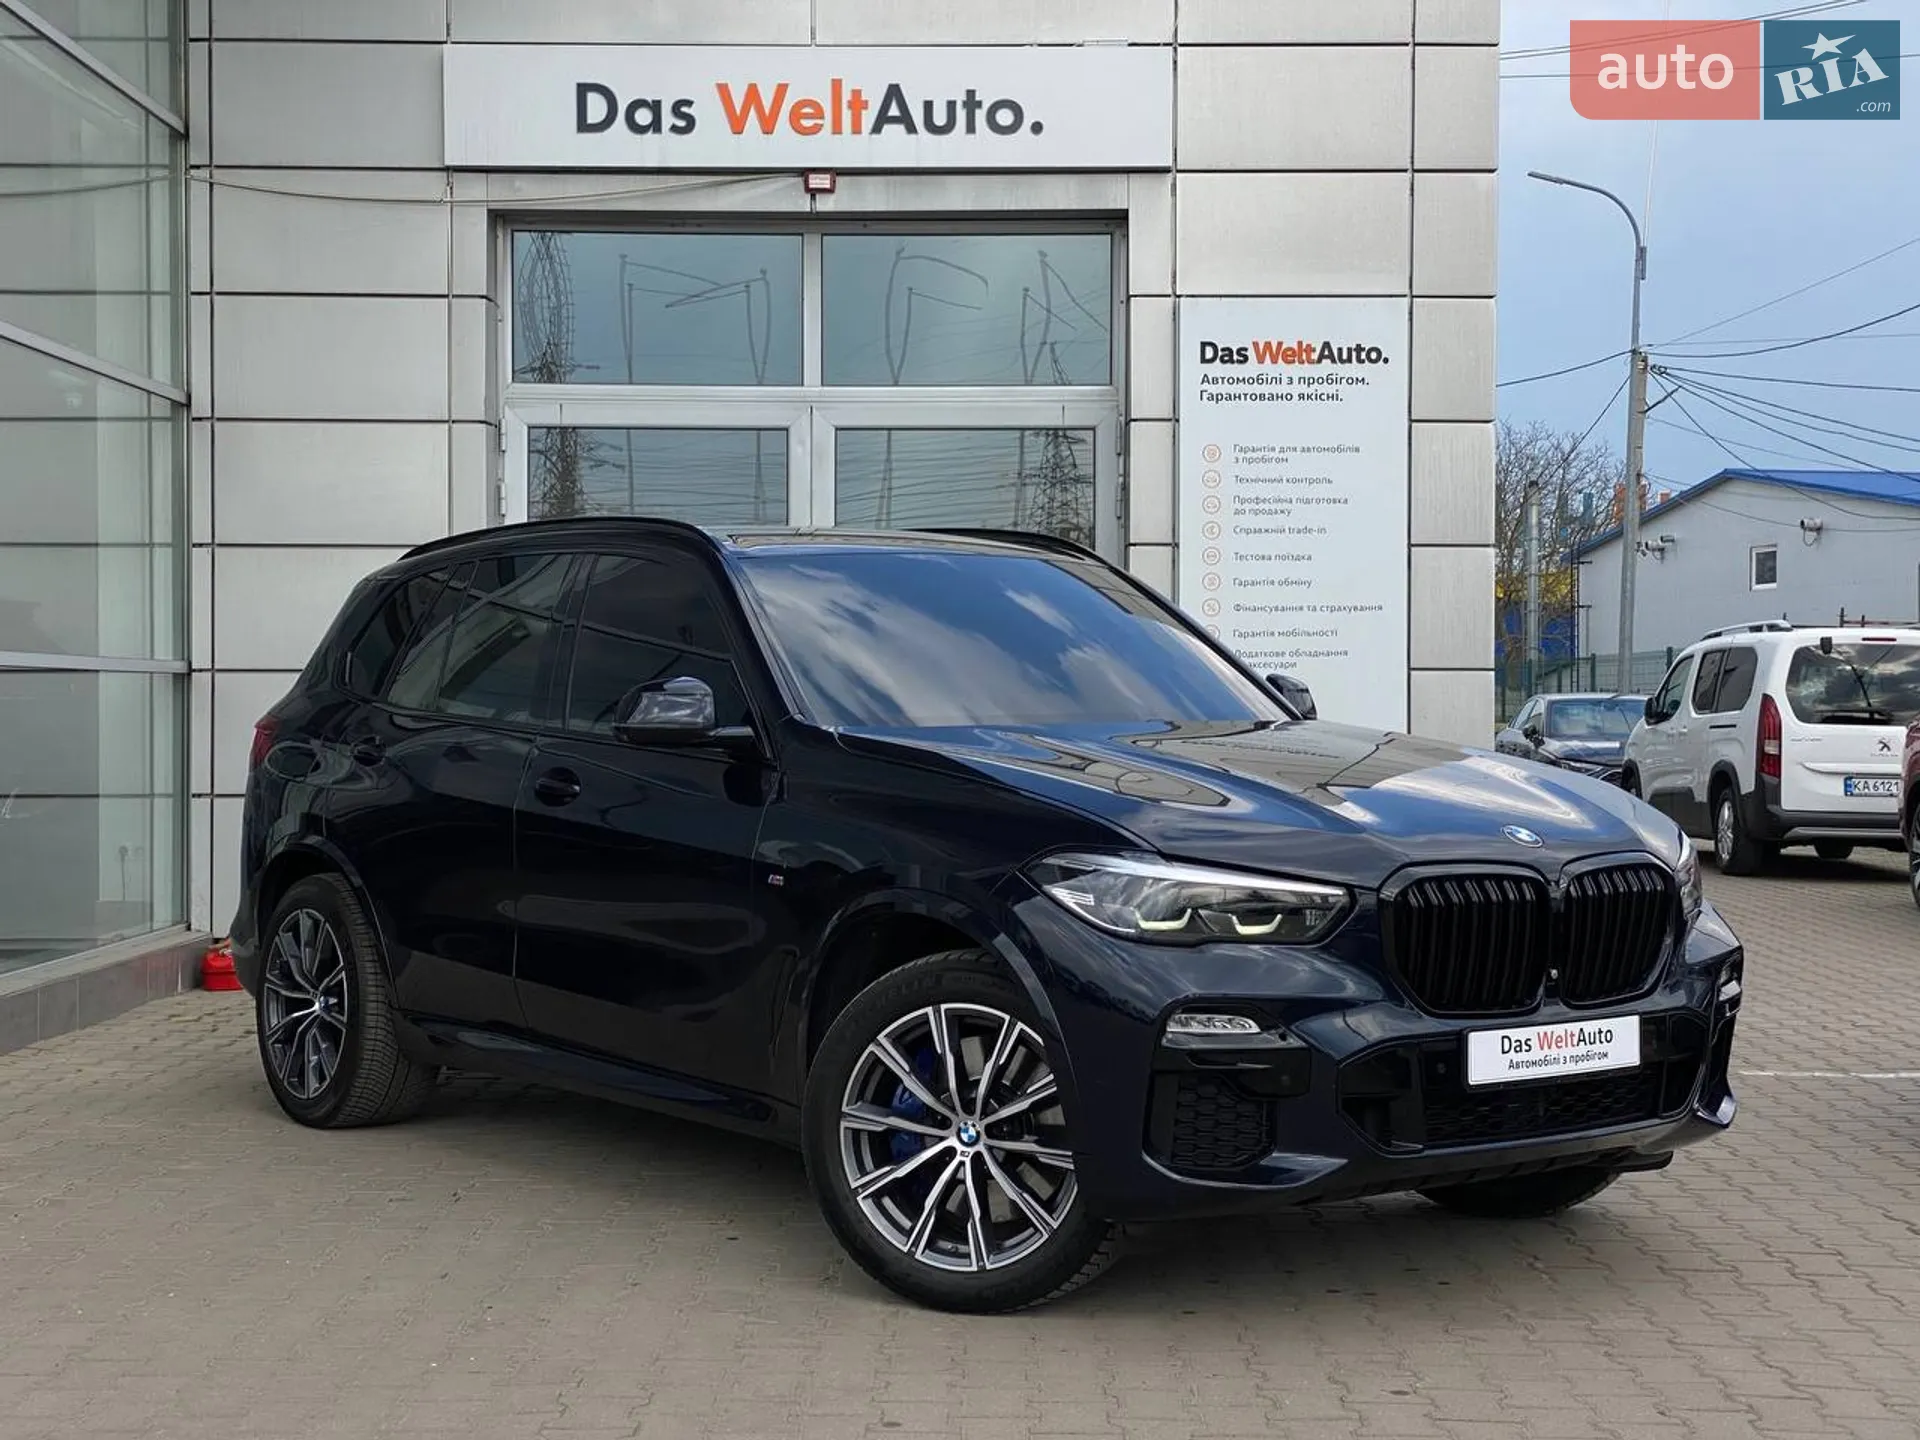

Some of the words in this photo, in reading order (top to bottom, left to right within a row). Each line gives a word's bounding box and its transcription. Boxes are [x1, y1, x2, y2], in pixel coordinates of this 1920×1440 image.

[576, 83, 696, 135] Das
[716, 79, 1043, 136] WeltAuto.
[1200, 341, 1249, 364] Das
[1253, 341, 1389, 365] WeltAuto.
[1201, 373, 1282, 385] Автомобілі
[1287, 377, 1293, 385] з
[1298, 373, 1369, 387] пробігом.
[1200, 390, 1293, 404] Гарантовано
[1298, 389, 1343, 402] якісні.
[1233, 444, 1277, 454] Гарантія
[1278, 446, 1298, 454] для
[1285, 476, 1334, 487] контроль
[1233, 507, 1247, 516] до
[1248, 507, 1293, 518] продажу
[1287, 525, 1327, 535] trade-in
[1233, 551, 1273, 562] Тестова
[1232, 578, 1275, 588] Гарантія
[1306, 604, 1318, 613] та
[1232, 629, 1276, 639] Гарантія
[1501, 1035, 1532, 1055] Das
[1537, 1027, 1613, 1051] WeltAuto
[1508, 1054, 1560, 1070] Автомобілі
[1562, 1055, 1567, 1065] з
[1569, 1050, 1609, 1065] пробігом
